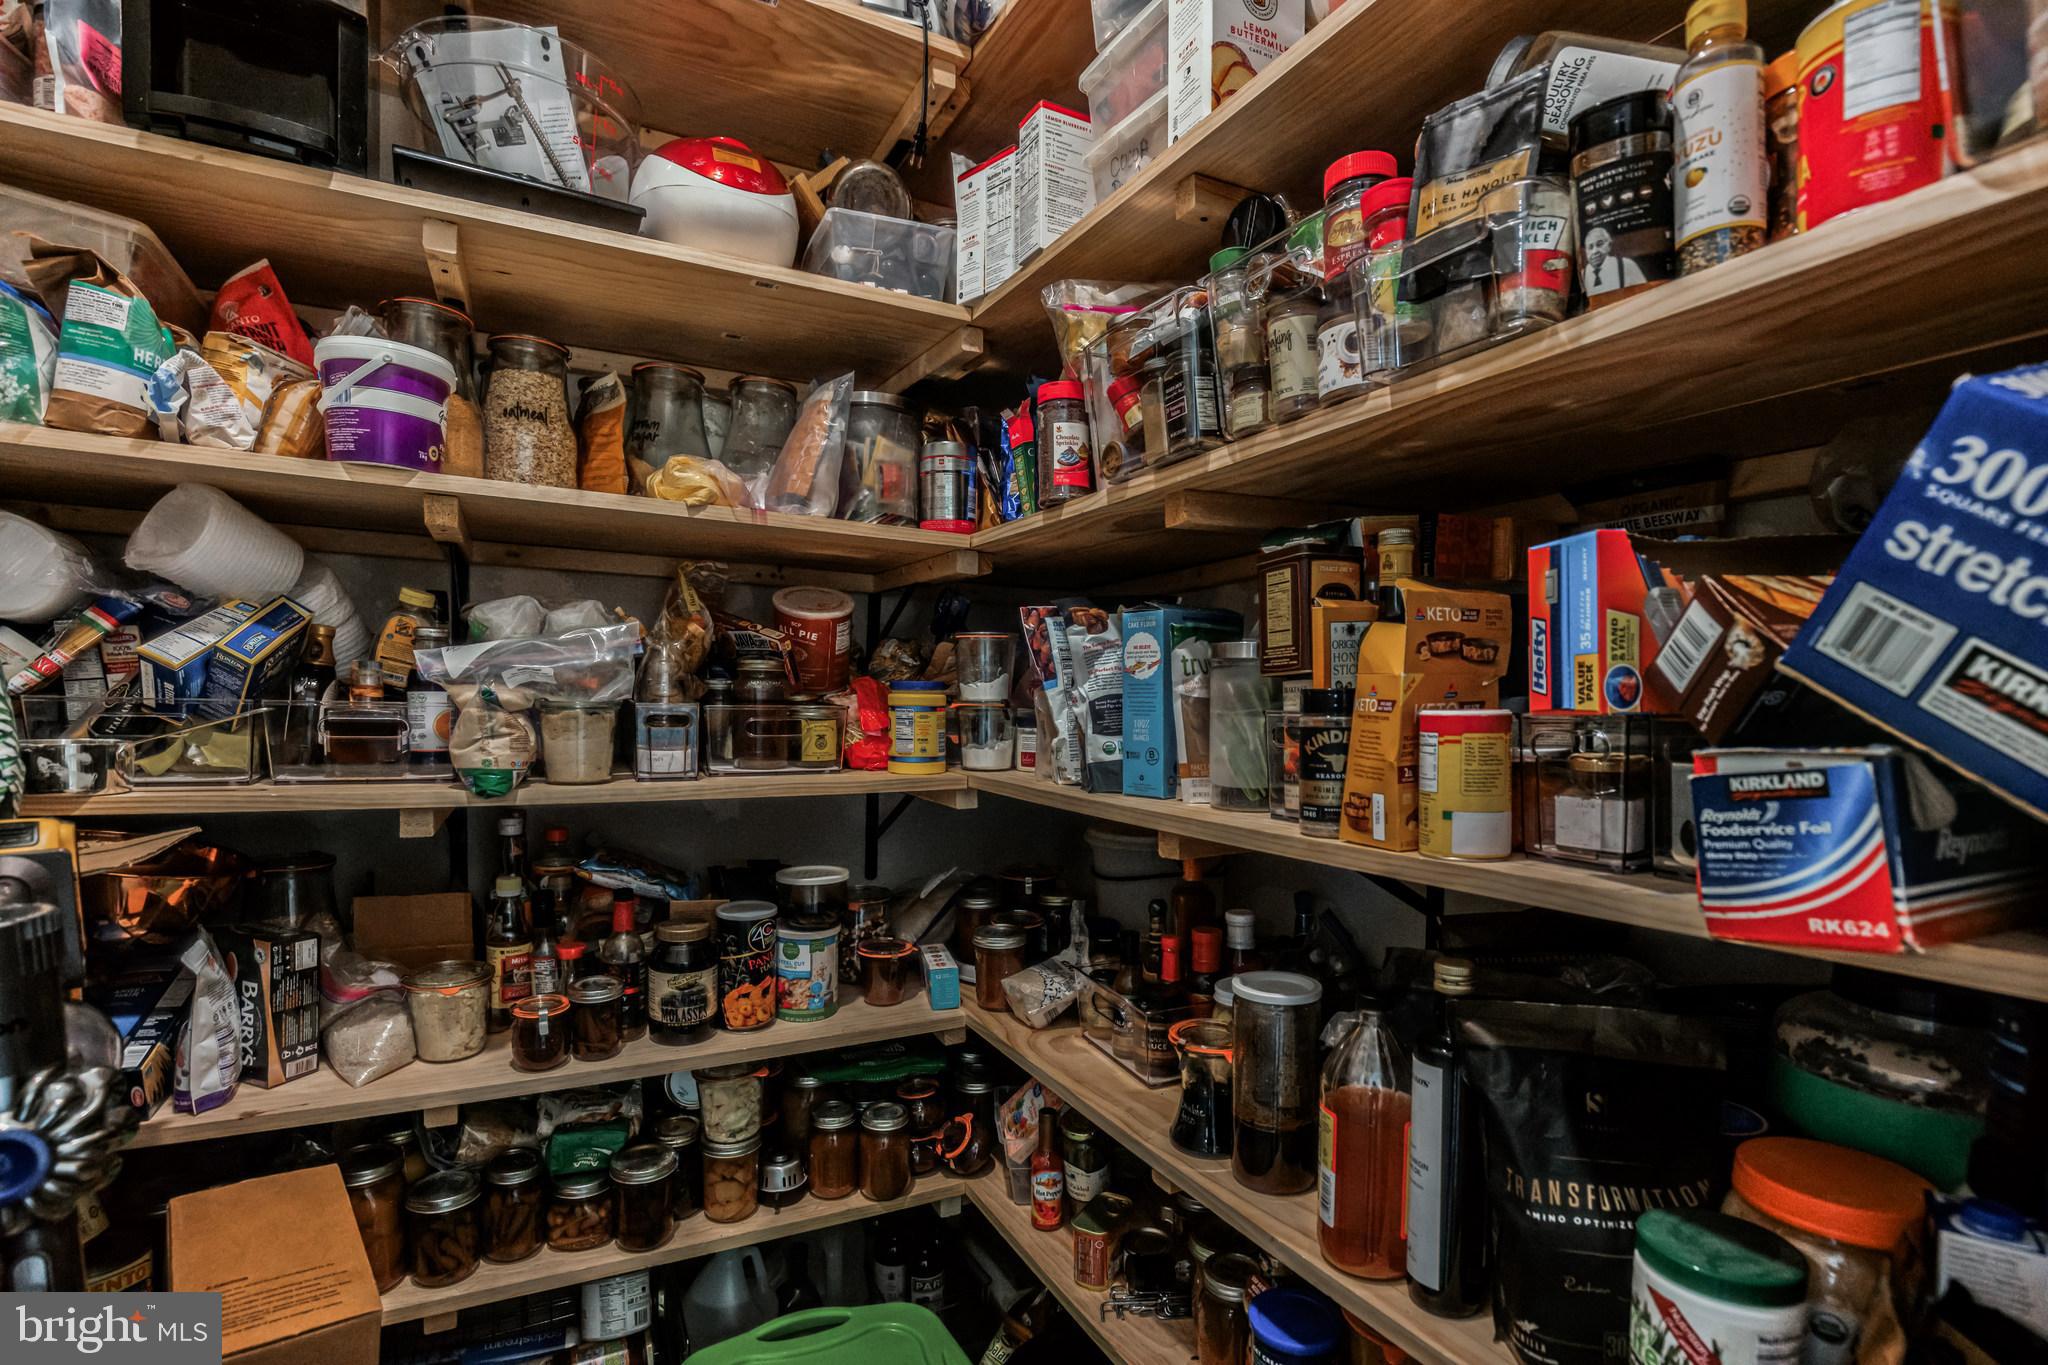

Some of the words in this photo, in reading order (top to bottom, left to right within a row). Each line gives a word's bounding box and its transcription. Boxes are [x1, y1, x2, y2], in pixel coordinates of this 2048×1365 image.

[1243, 20, 1278, 40] LEMON
[1543, 60, 1571, 115] POULTRY
[1548, 56, 1586, 125] SEASONING
[1559, 85, 1583, 130] CONDIMENTO
[1576, 68, 1589, 87] PARA
[1584, 54, 1597, 69] AVES
[1442, 194, 1457, 204] EL
[502, 401, 549, 426] oatmeal
[1055, 434, 1080, 442] Chocolate
[1055, 440, 1080, 448] Sprinkles
[1931, 435, 2048, 517] 300
[1621, 497, 1686, 516] ORGANIC
[1924, 483, 2013, 529] SQUARE
[1643, 510, 1701, 529] BEESWAX
[1883, 518, 2048, 626] stretc
[1426, 606, 1461, 622] KETO
[734, 632, 757, 649] JAVA
[798, 630, 819, 641] PIE
[1579, 632, 1592, 650] 35
[1532, 618, 1547, 692] Hefty
[1577, 661, 1585, 705] VALUE
[1133, 719, 1150, 729] 100%
[1728, 771, 1825, 792] KIRKLAND
[1700, 808, 1762, 825] Reynolds
[1701, 822, 1796, 837] Foodservice
[1799, 820, 1832, 835] Foil
[1702, 839, 1751, 850] Premium
[1752, 837, 1793, 851] Quality
[1807, 917, 1891, 938] RK624
[240, 979, 259, 1067] BARRY'S
[660, 1006, 708, 1024] MOLASSES
[1505, 1166, 1711, 1213] TRANSFORMATION
[1526, 1208, 1568, 1224] AMINO
